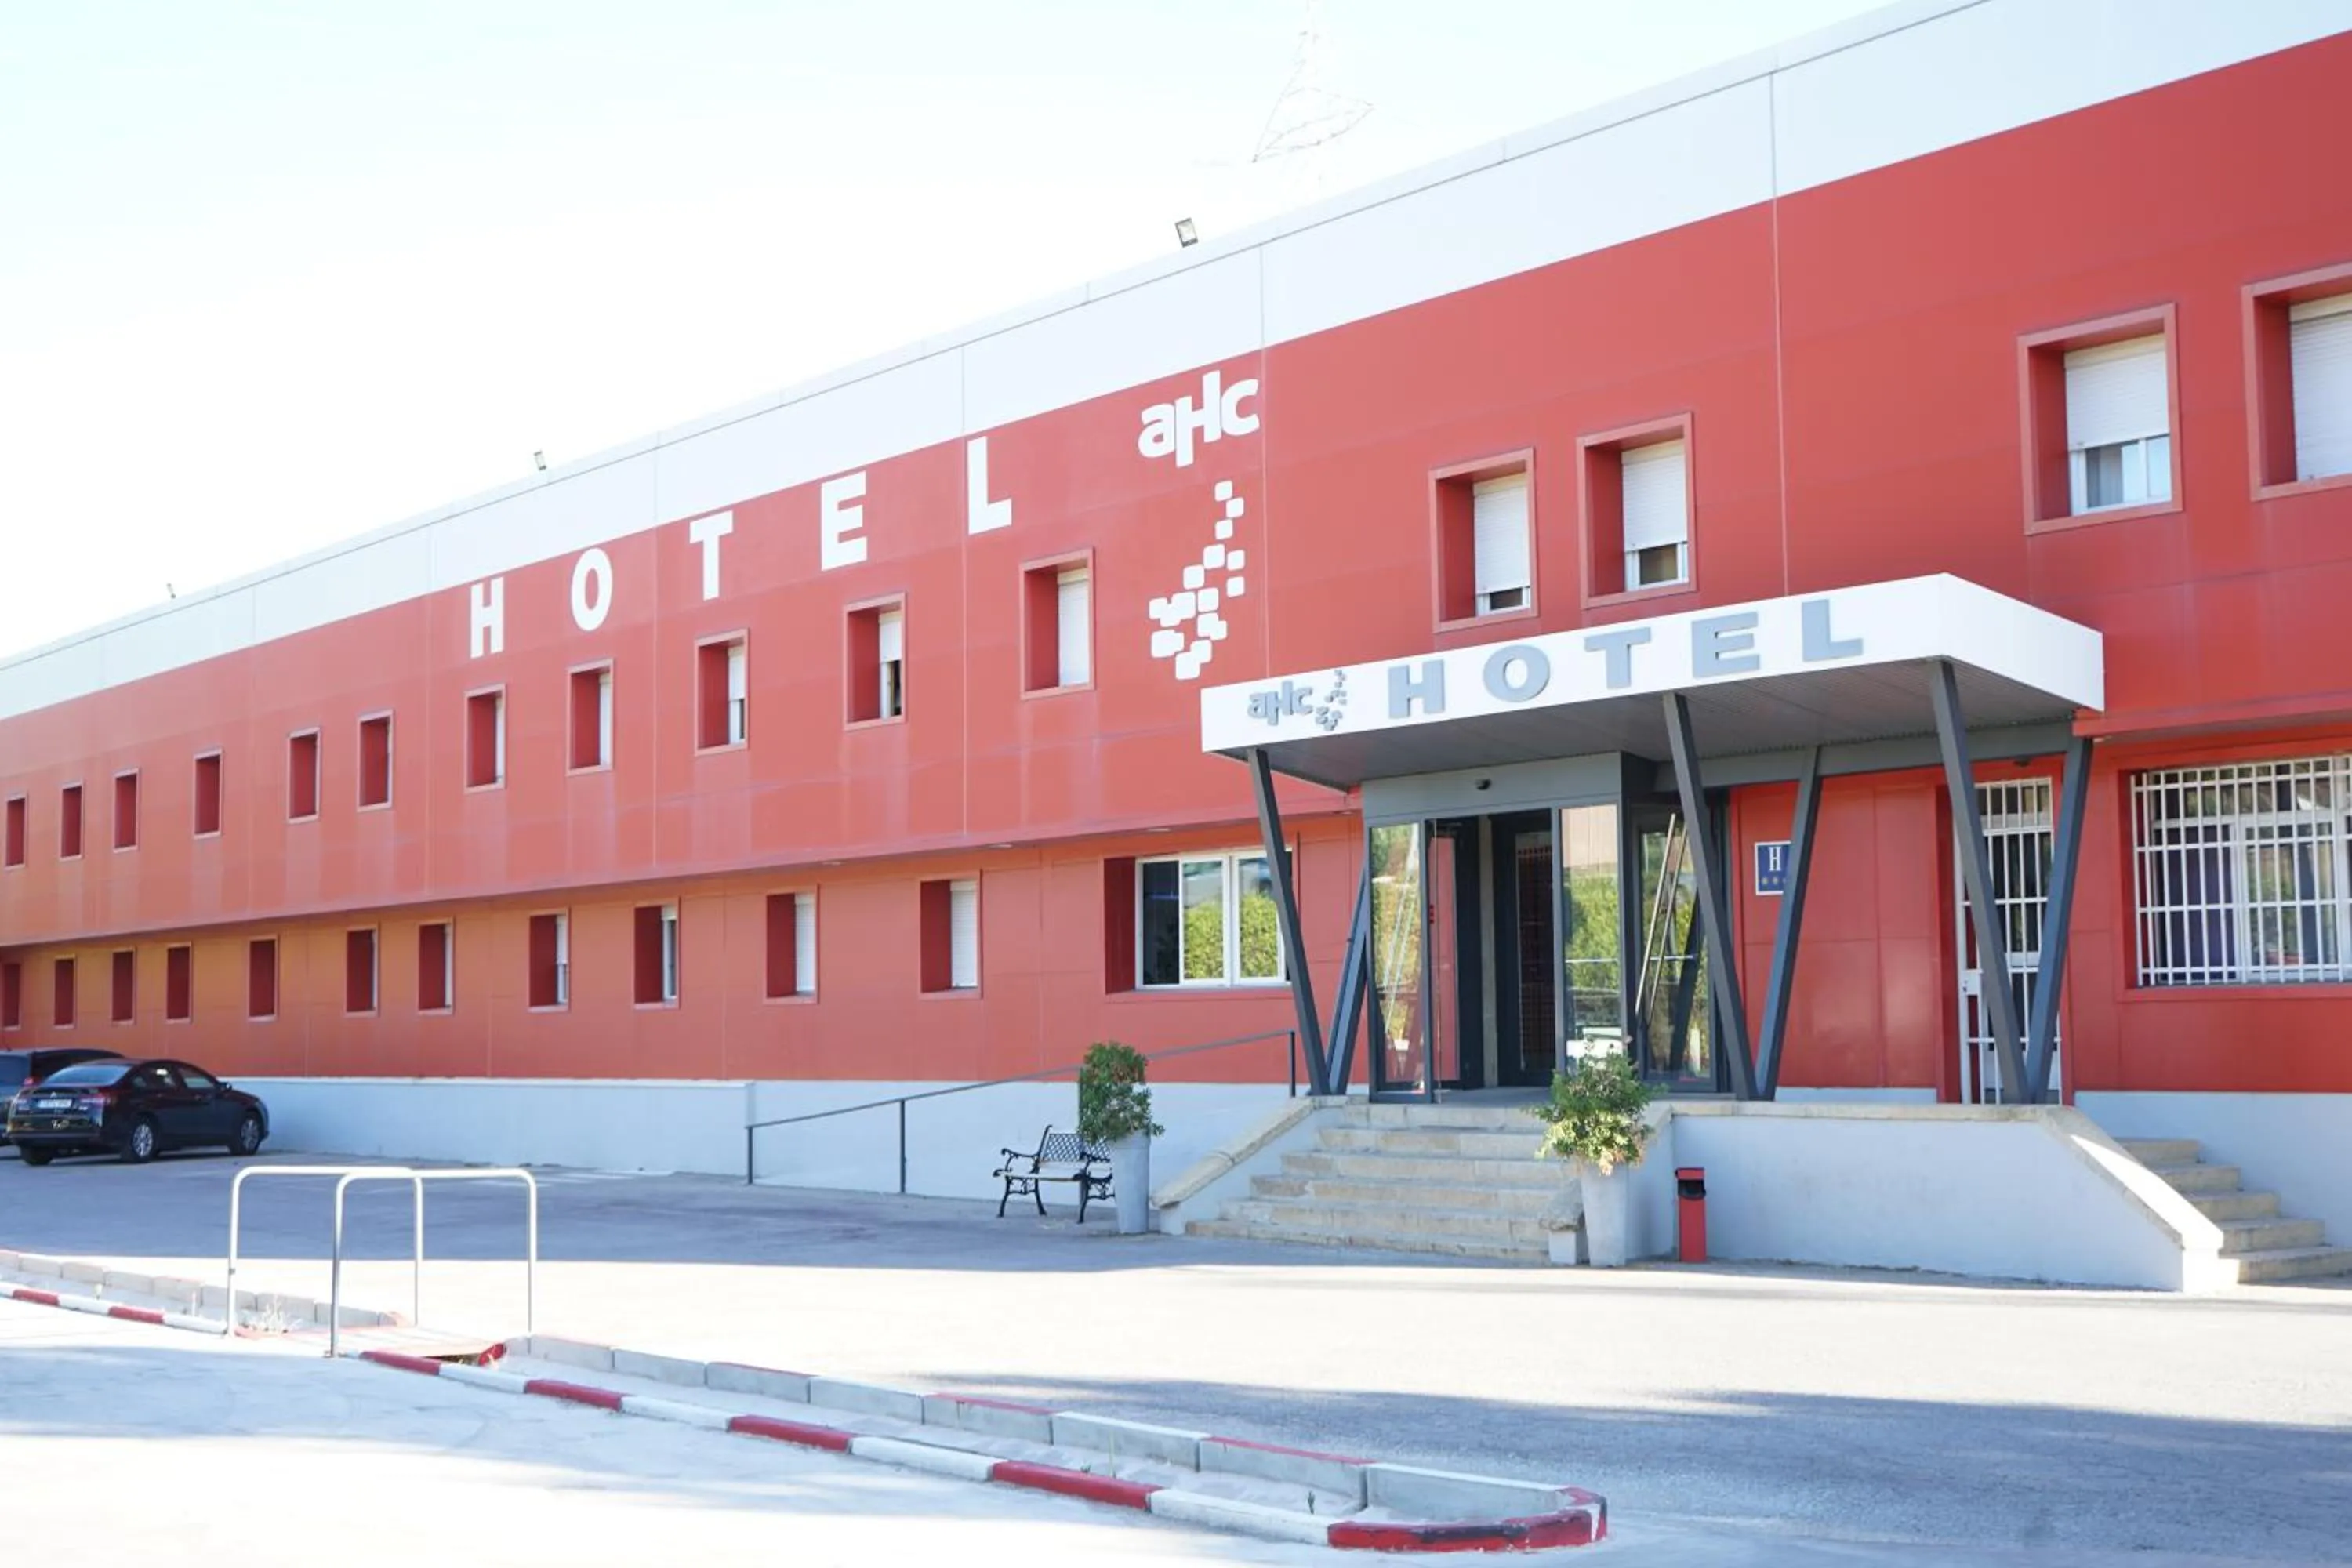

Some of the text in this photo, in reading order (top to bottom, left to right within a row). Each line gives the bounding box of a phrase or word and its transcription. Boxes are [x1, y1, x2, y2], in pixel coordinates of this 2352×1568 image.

[470, 436, 1012, 659] HOTEL
[1387, 598, 1864, 720] HOTEL
[1769, 846, 1781, 871] H
